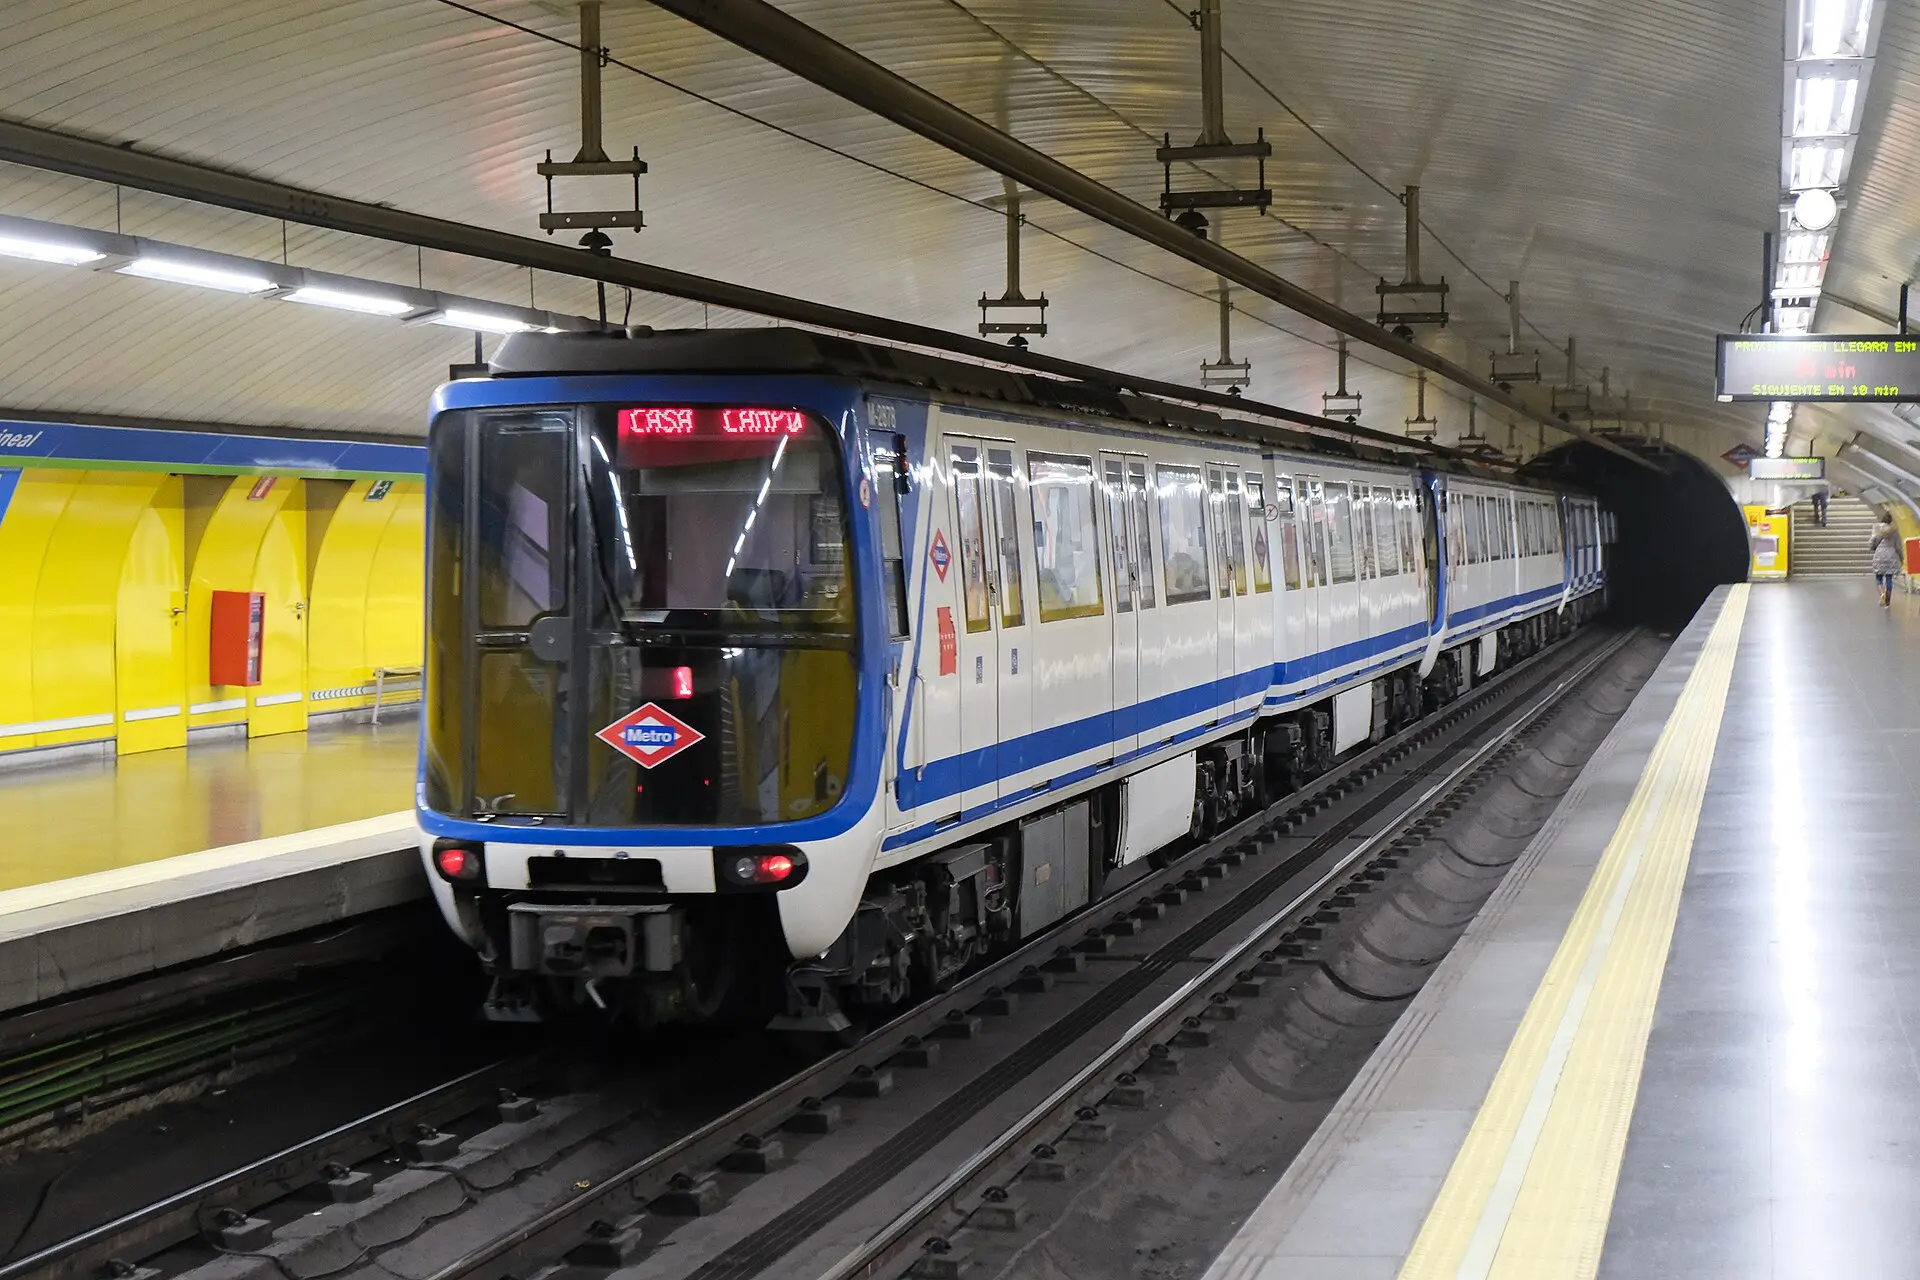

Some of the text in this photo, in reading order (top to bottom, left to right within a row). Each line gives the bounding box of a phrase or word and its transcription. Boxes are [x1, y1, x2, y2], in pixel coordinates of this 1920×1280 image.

[1833, 341, 1889, 353] LLEGARA
[1828, 384, 1845, 396] EN
[1874, 384, 1899, 396] min
[629, 409, 694, 433] CASA
[626, 728, 673, 743] Metro
